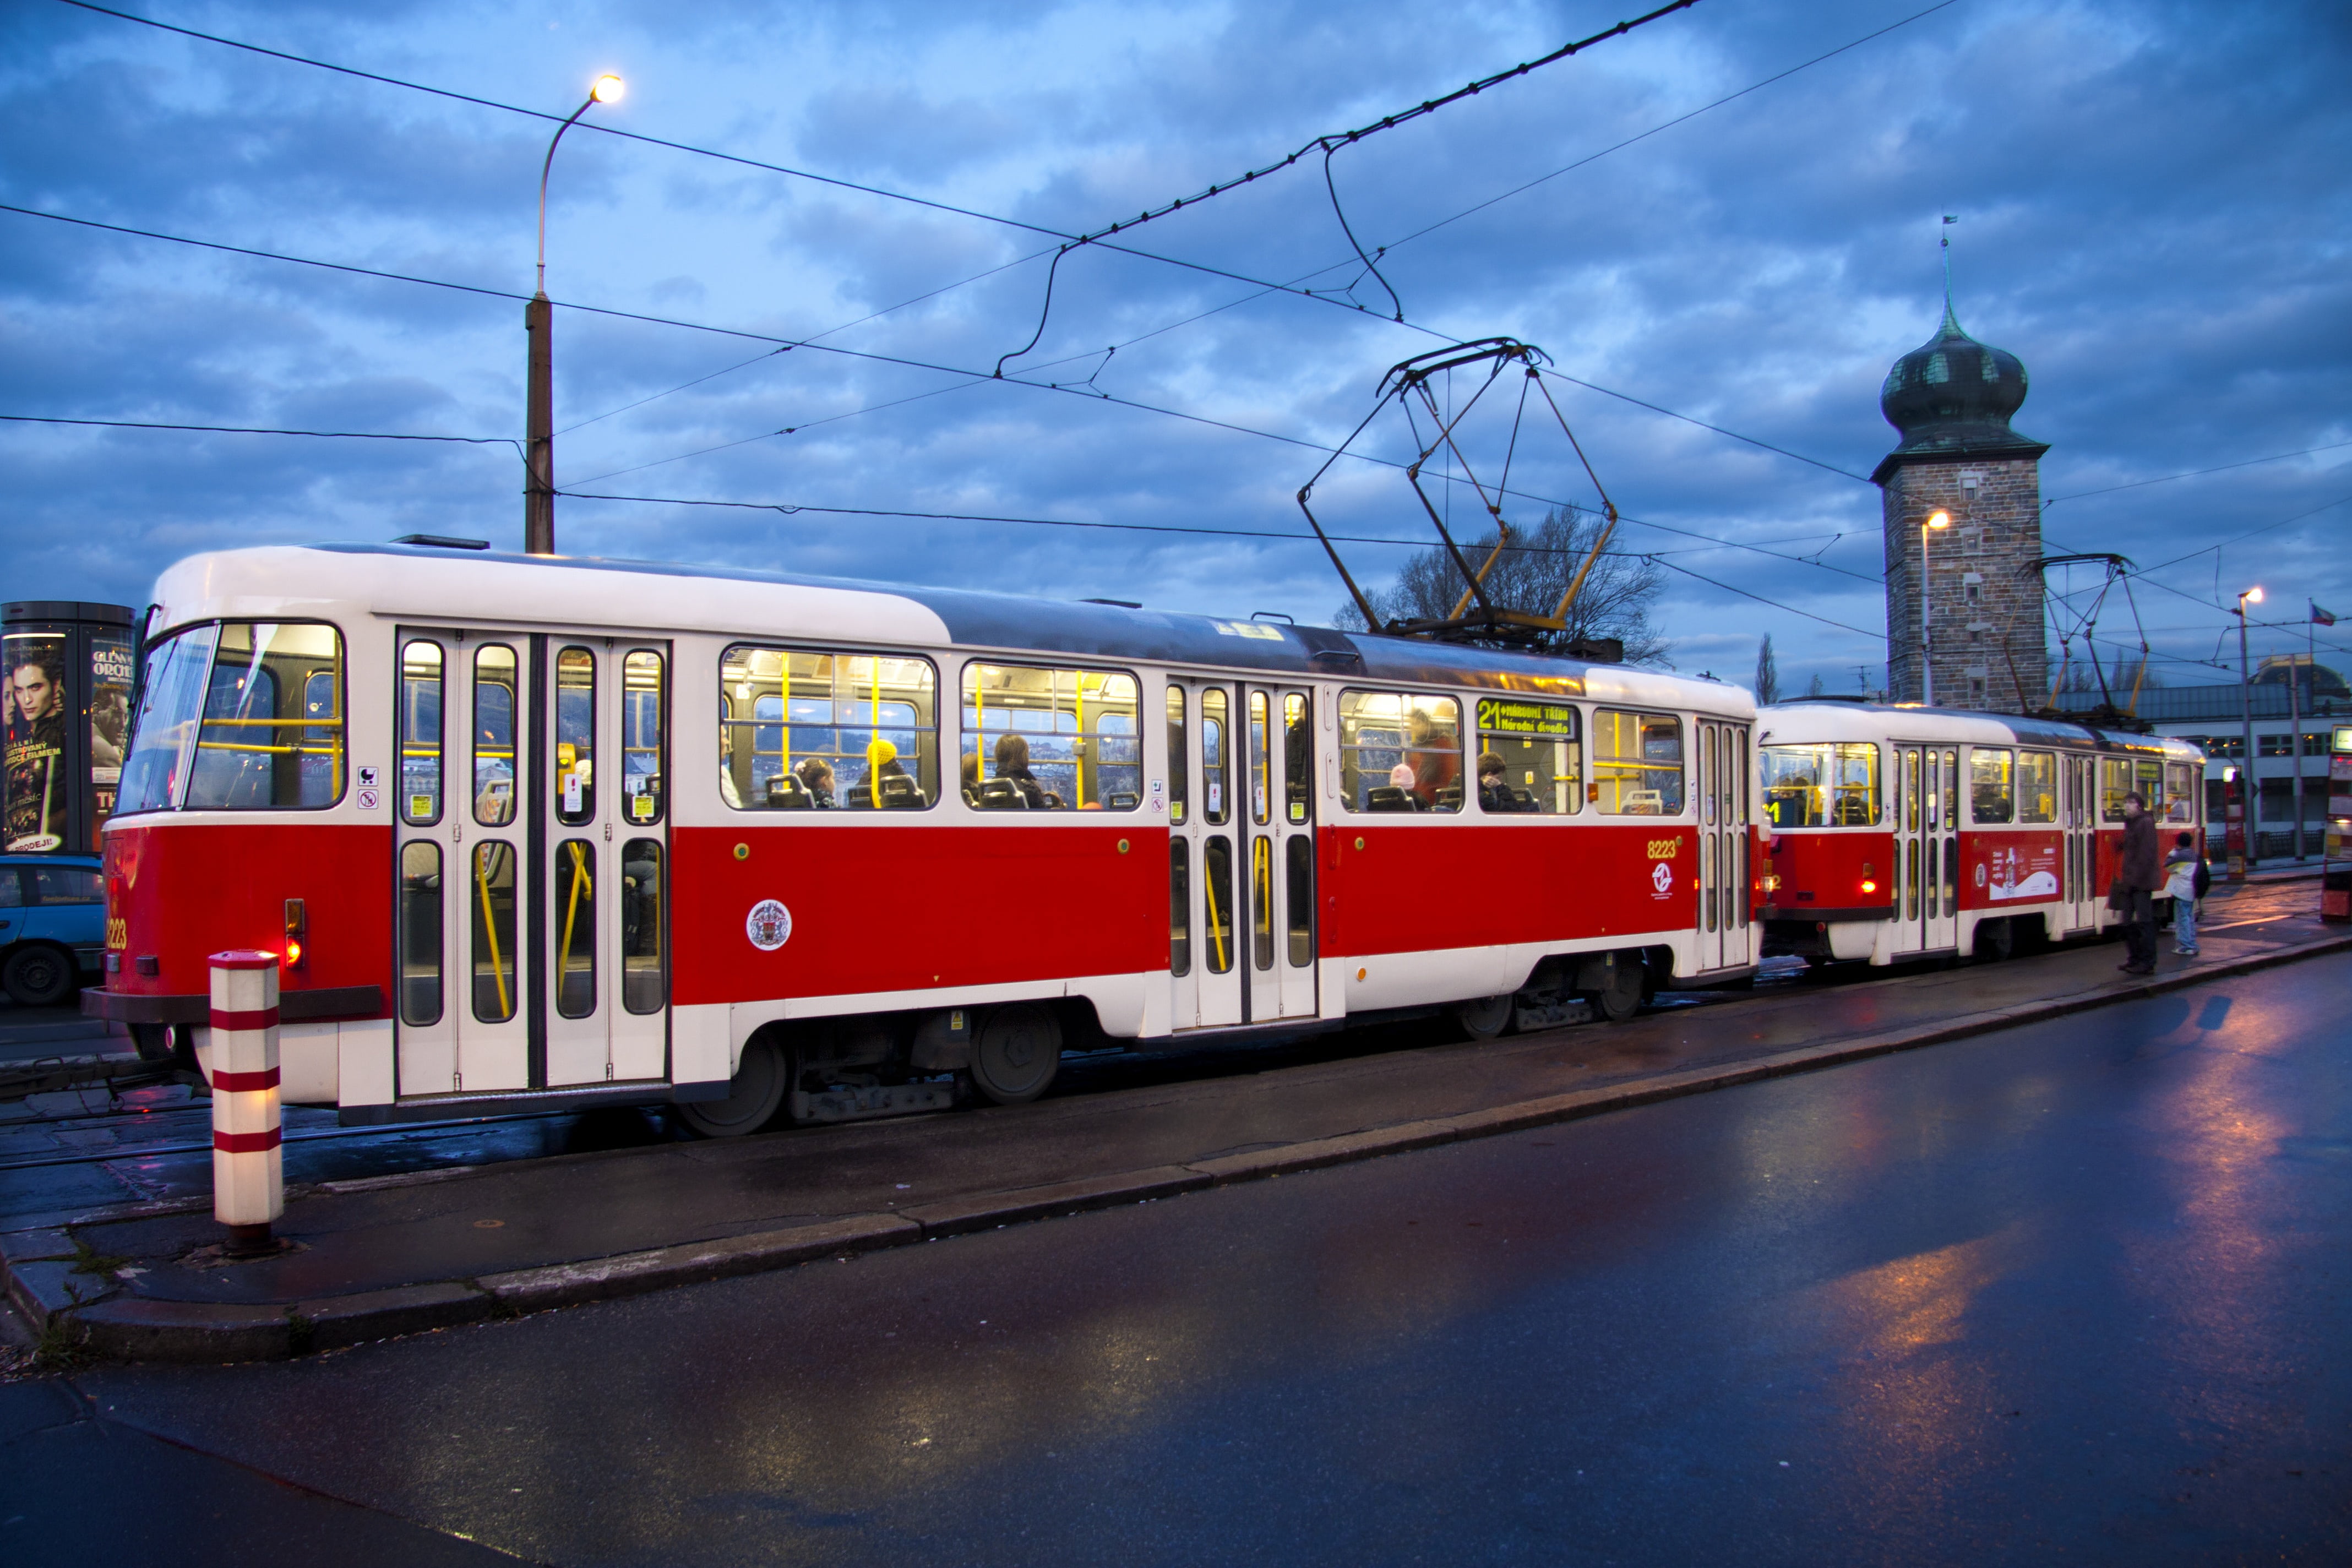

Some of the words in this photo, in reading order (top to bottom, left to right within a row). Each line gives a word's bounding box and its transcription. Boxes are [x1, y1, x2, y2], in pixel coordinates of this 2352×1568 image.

[93, 651, 127, 664] GLENN
[1478, 700, 1500, 729] 21
[1506, 704, 1542, 719] NÁRODNÍ
[1544, 707, 1569, 721] TŘÍDA
[1501, 718, 1535, 731] Národní
[1537, 721, 1569, 734] divadlo
[26, 748, 62, 760] FILMEM
[1648, 840, 1675, 859] 8223
[106, 918, 127, 950] 8223
